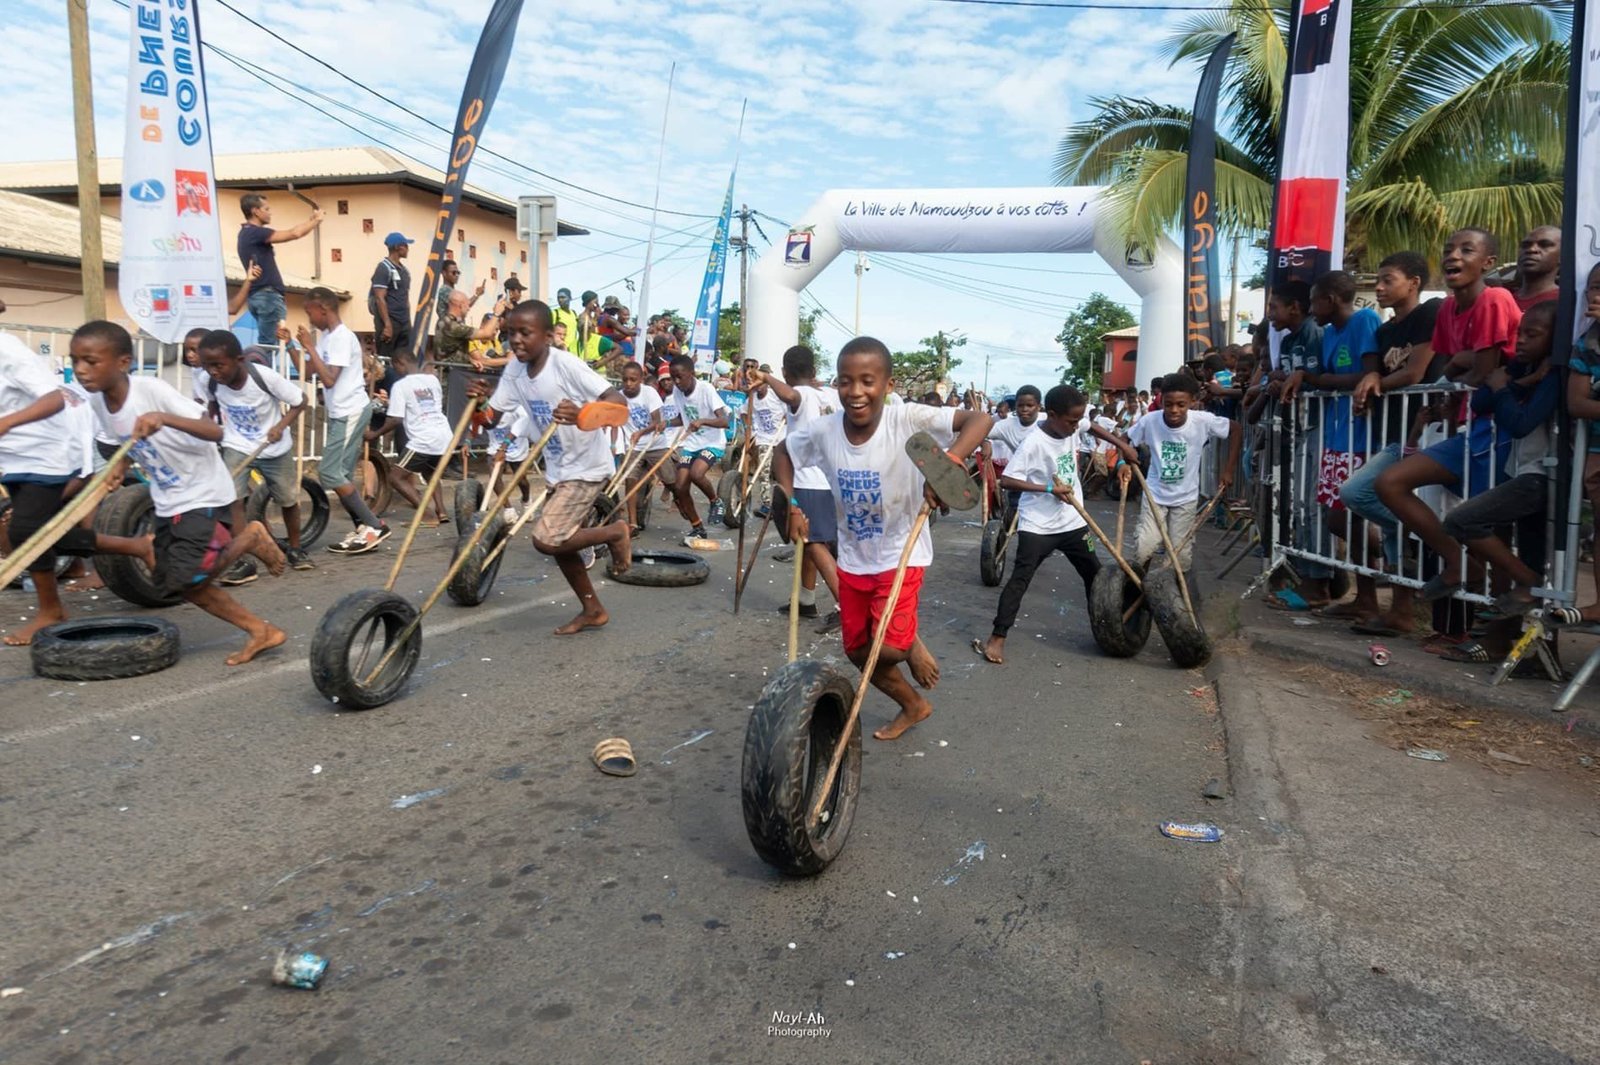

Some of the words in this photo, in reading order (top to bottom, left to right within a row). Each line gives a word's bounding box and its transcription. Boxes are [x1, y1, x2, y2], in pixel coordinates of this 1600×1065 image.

[844, 201, 858, 216] La
[862, 201, 887, 216] Ville
[889, 202, 907, 216] de
[909, 201, 993, 220] Mamoudzou
[1008, 205, 1031, 216] vos
[837, 468, 872, 478] COURSE
[838, 477, 881, 490] PNEUS
[842, 490, 881, 505] MAY
